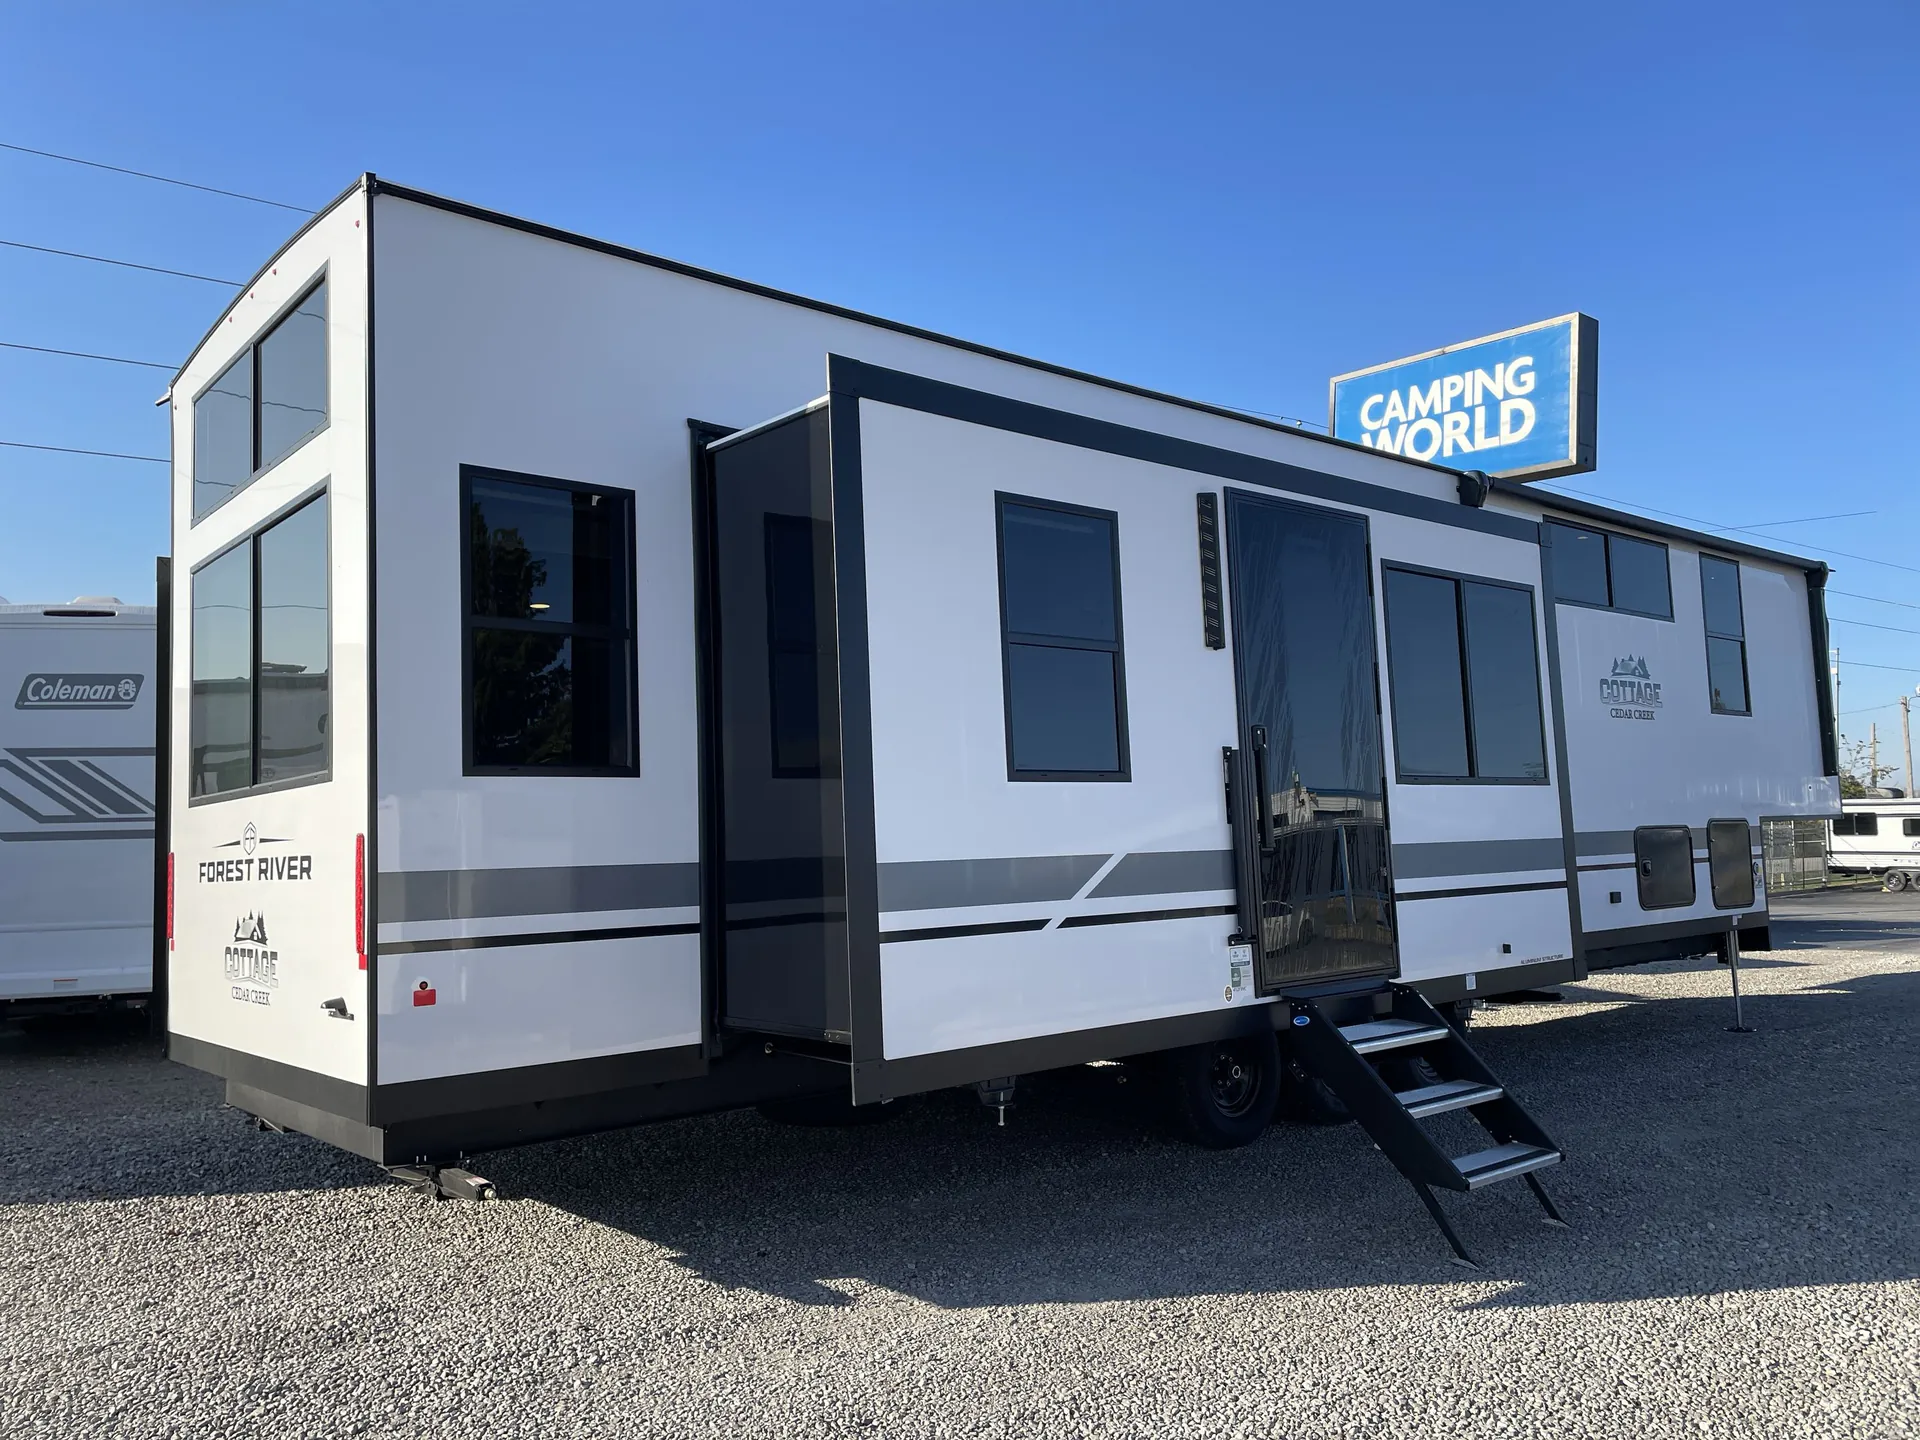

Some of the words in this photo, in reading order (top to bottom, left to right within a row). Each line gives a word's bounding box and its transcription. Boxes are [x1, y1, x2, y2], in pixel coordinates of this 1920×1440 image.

[1360, 355, 1536, 431] CAMPING
[1361, 398, 1536, 463] WORLD
[27, 677, 115, 702] Coleman
[1600, 678, 1663, 708] COTTAGE
[1610, 708, 1634, 719] CEDAR
[1634, 709, 1655, 720] CREEK
[199, 859, 254, 883] FOREST
[258, 855, 312, 881] RIVER
[224, 946, 279, 989] COTTAGE
[231, 986, 250, 1002] CEDAR
[250, 990, 271, 1006] CREEK
